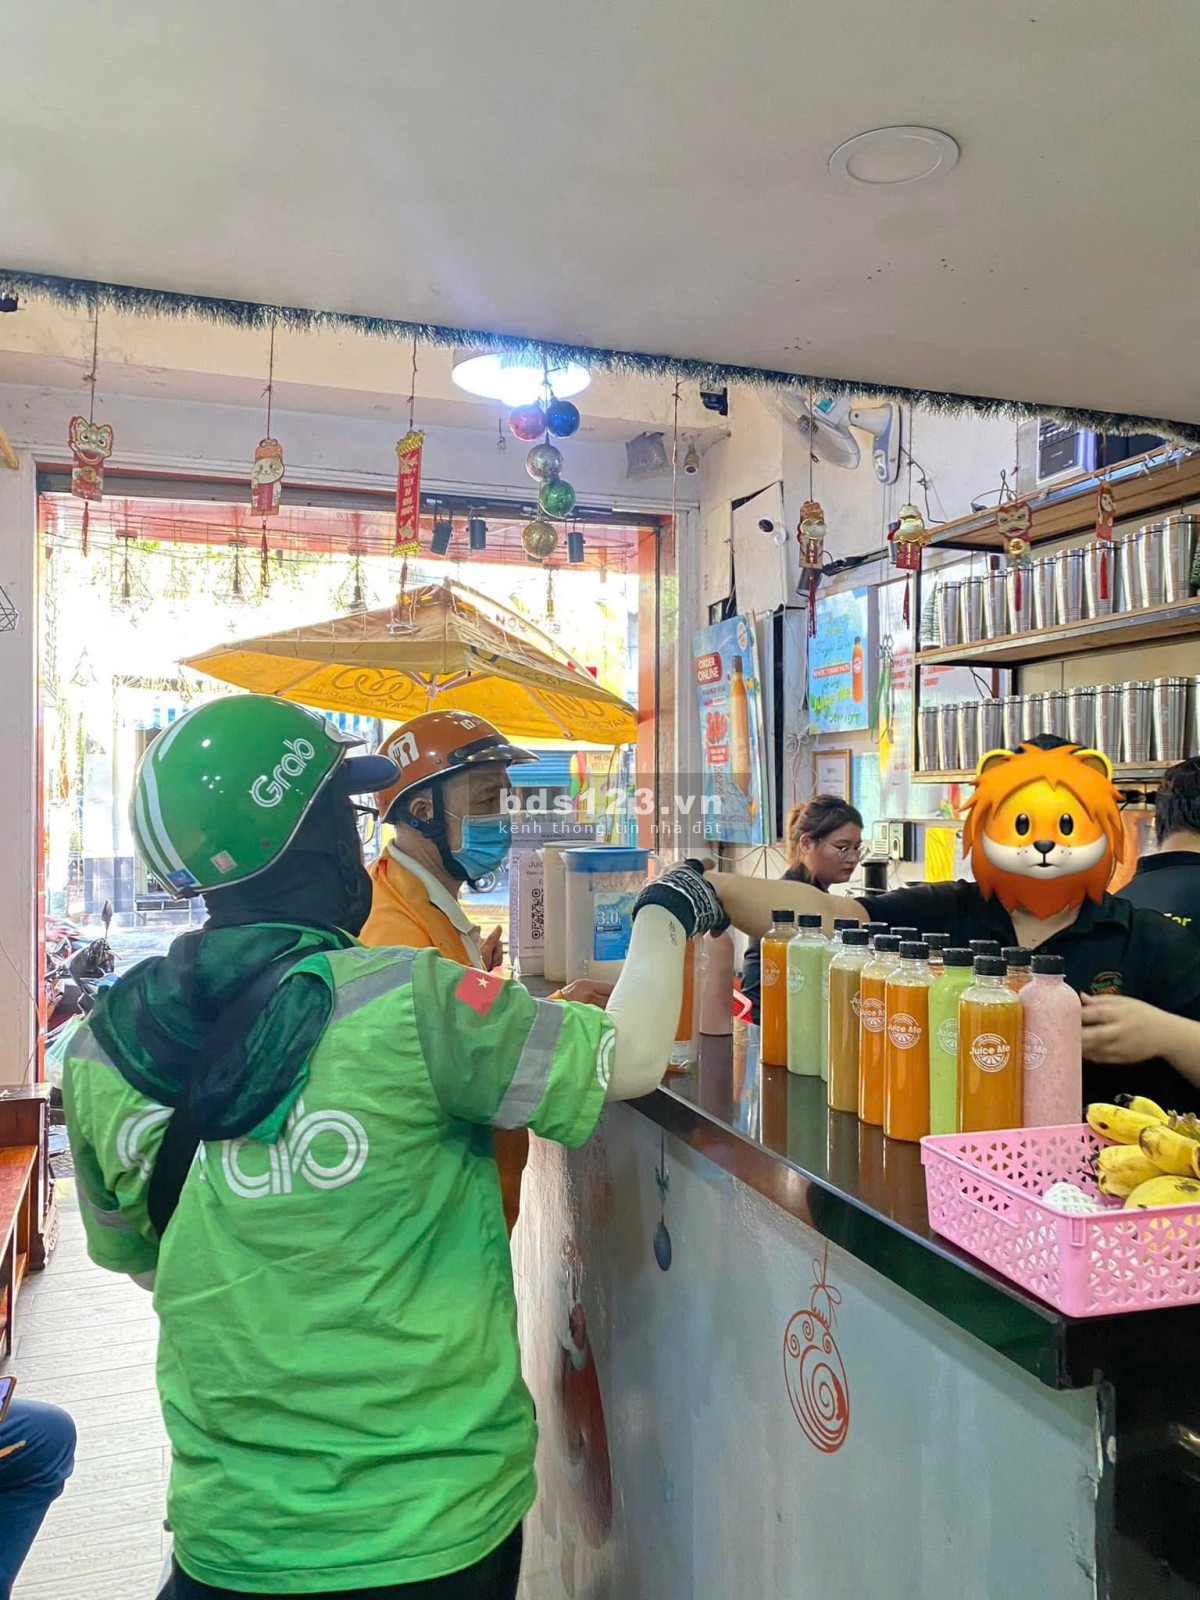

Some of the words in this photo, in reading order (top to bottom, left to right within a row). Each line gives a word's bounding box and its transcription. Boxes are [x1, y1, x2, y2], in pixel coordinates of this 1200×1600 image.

[698, 656, 716, 669] ORDER
[697, 666, 719, 681] ONLINE
[250, 738, 315, 808] Grab
[888, 1024, 906, 1033] Juice
[908, 1026, 922, 1034] Me
[969, 1046, 995, 1055] Juice
[997, 1044, 1011, 1053] Me
